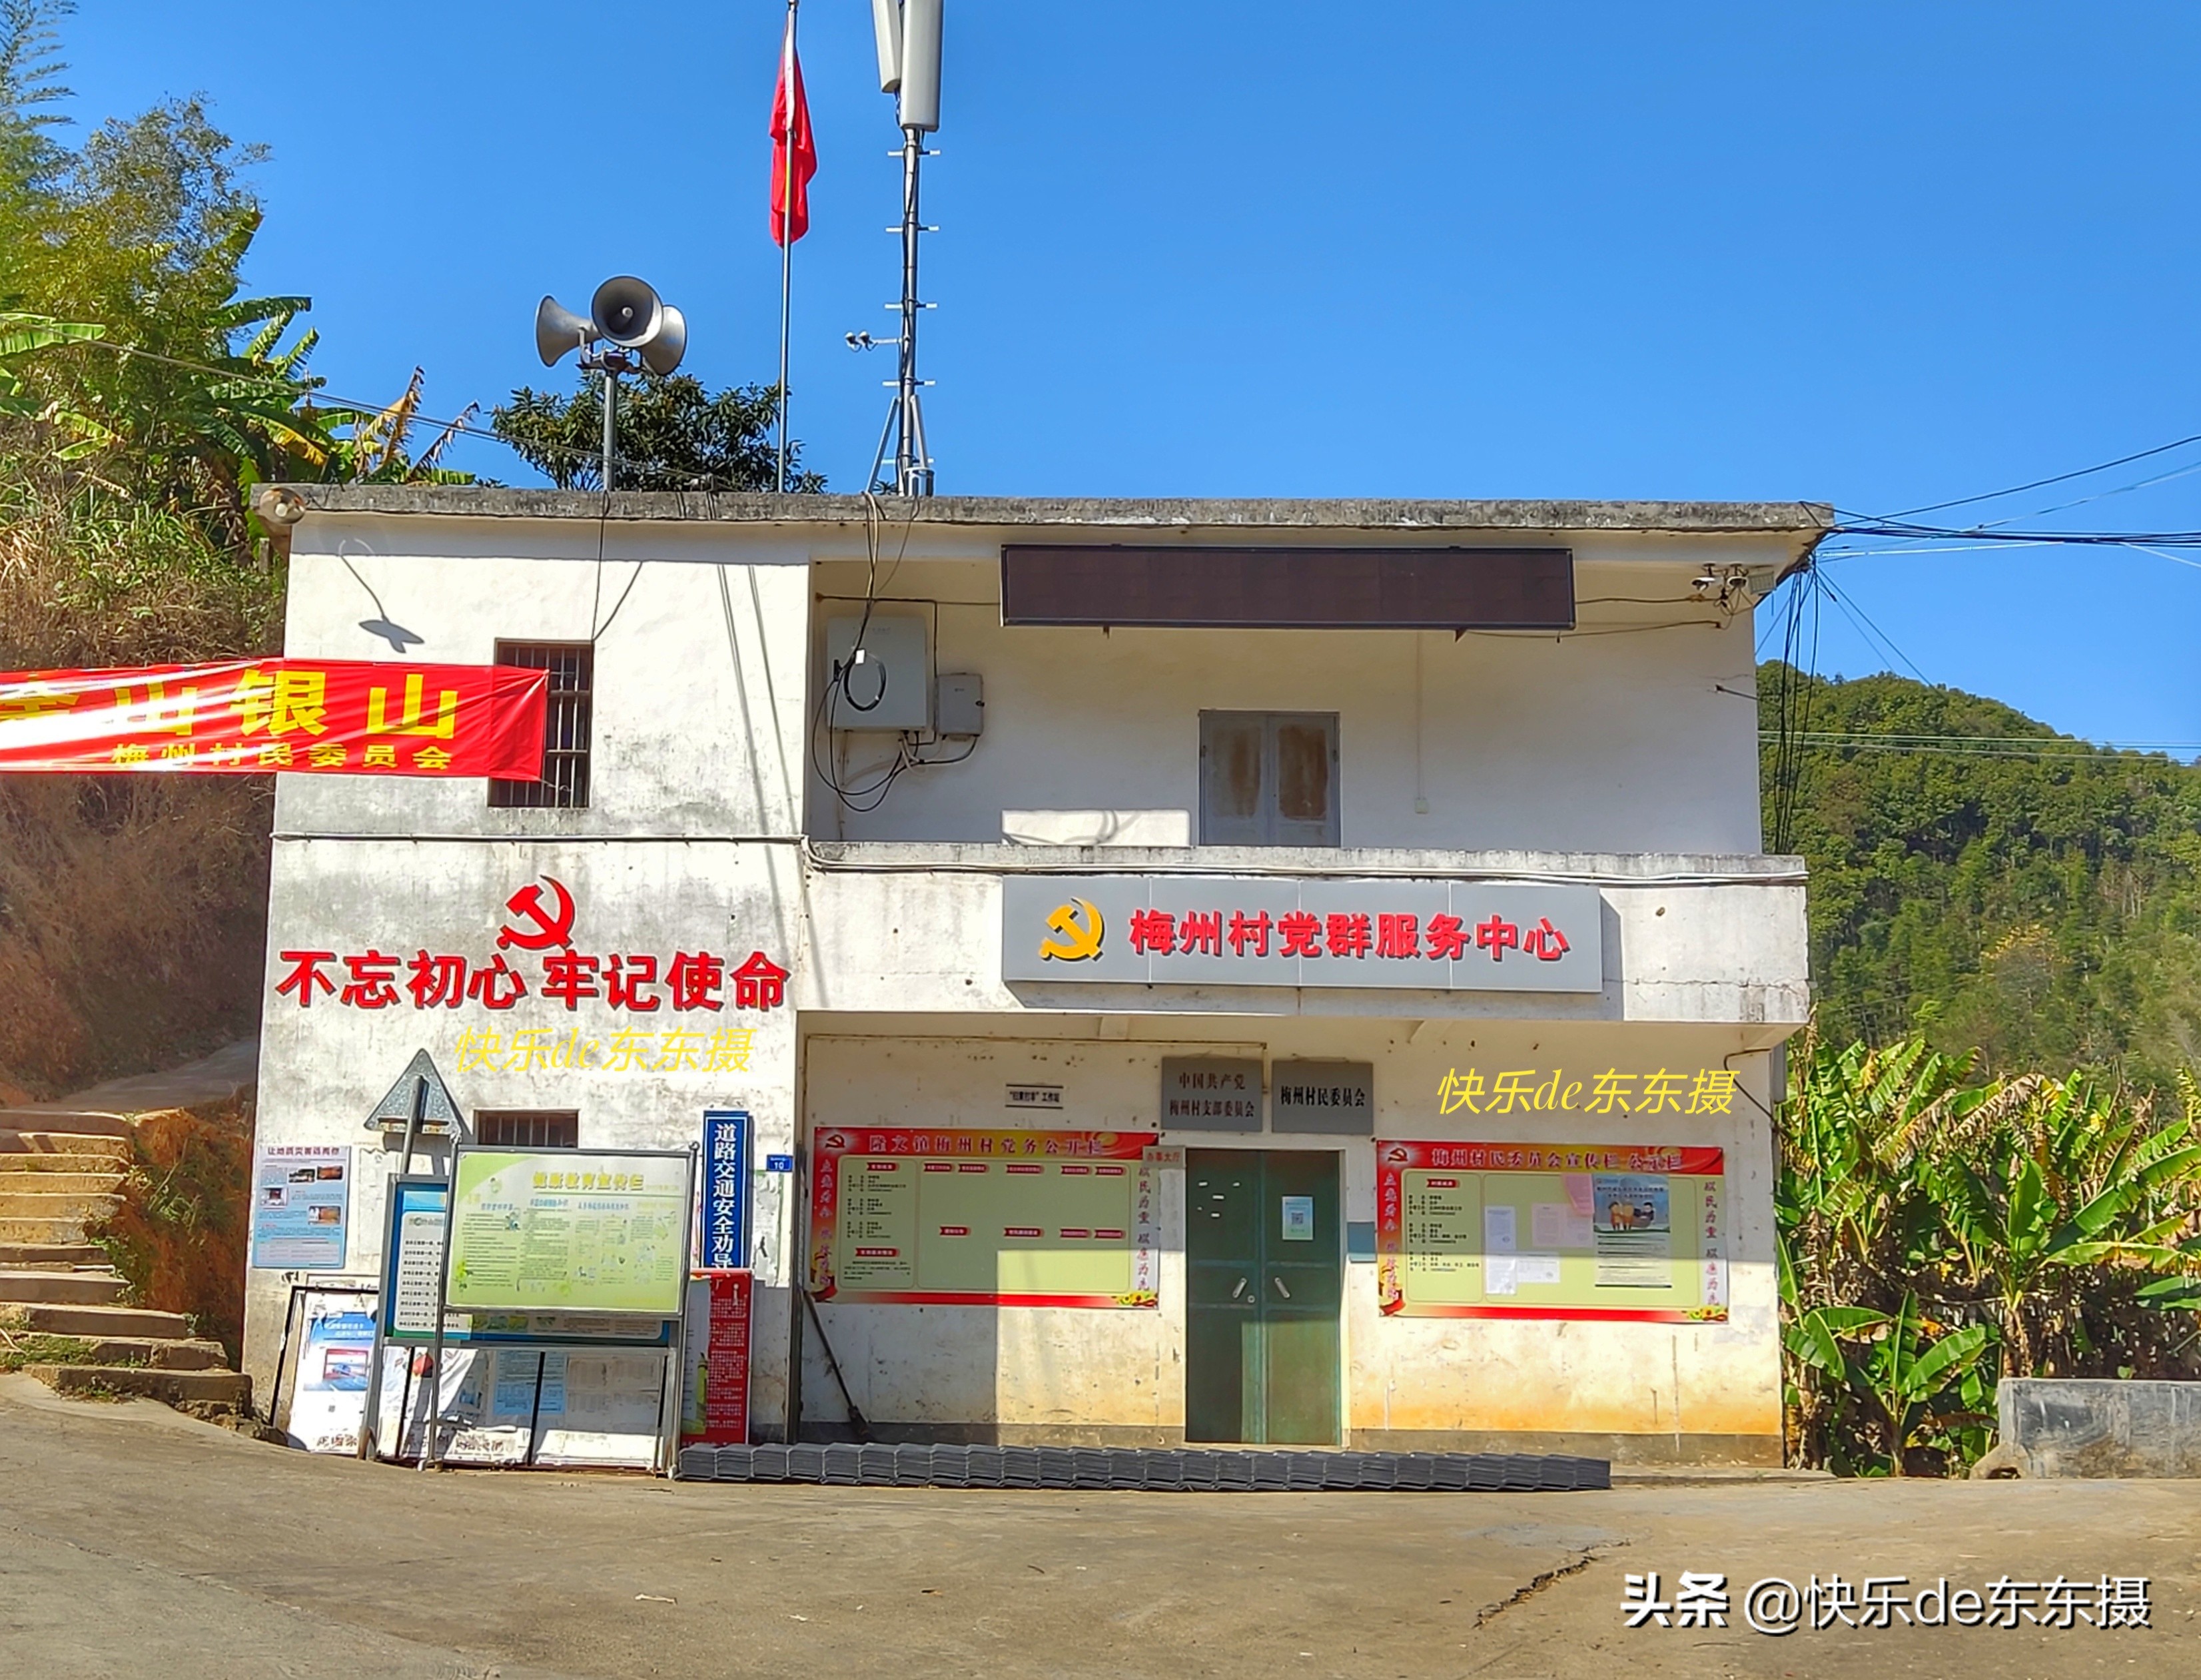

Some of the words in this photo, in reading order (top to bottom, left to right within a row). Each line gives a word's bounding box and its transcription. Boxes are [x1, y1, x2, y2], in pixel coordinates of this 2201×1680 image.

[111, 742, 452, 771] 梅州村民委员会
[1129, 907, 1571, 963] 梅州村党群服务中心
[274, 949, 791, 1012] 不忘初心牢记使命
[1179, 1072, 1246, 1090] 中国共产党
[1280, 1085, 1366, 1107] 梅州村民委员会
[1170, 1100, 1254, 1118] 梅州村支部委员会
[869, 1134, 1104, 1155] 隆文镇梅州村党务公开栏
